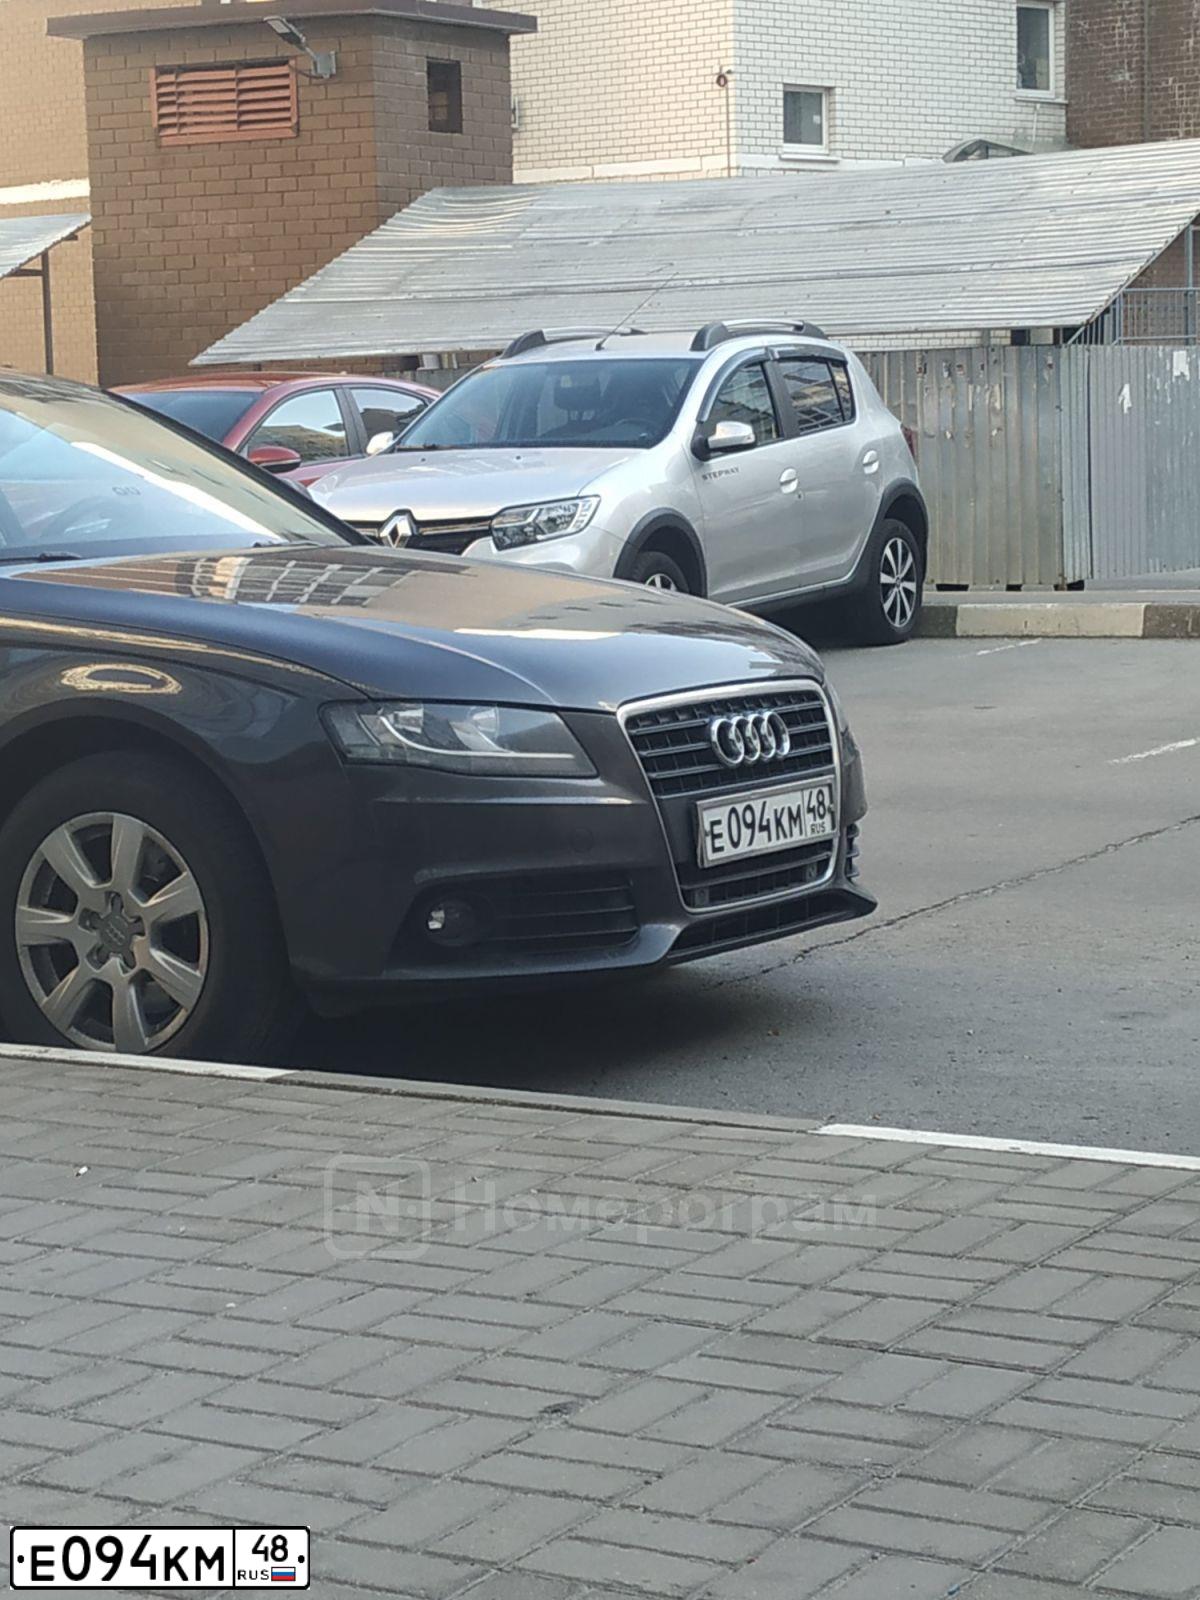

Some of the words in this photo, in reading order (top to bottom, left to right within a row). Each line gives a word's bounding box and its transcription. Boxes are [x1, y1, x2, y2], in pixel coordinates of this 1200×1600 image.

[709, 801, 803, 853] Е094КМ
[806, 789, 826, 820] 48
[810, 821, 826, 834] RUS
